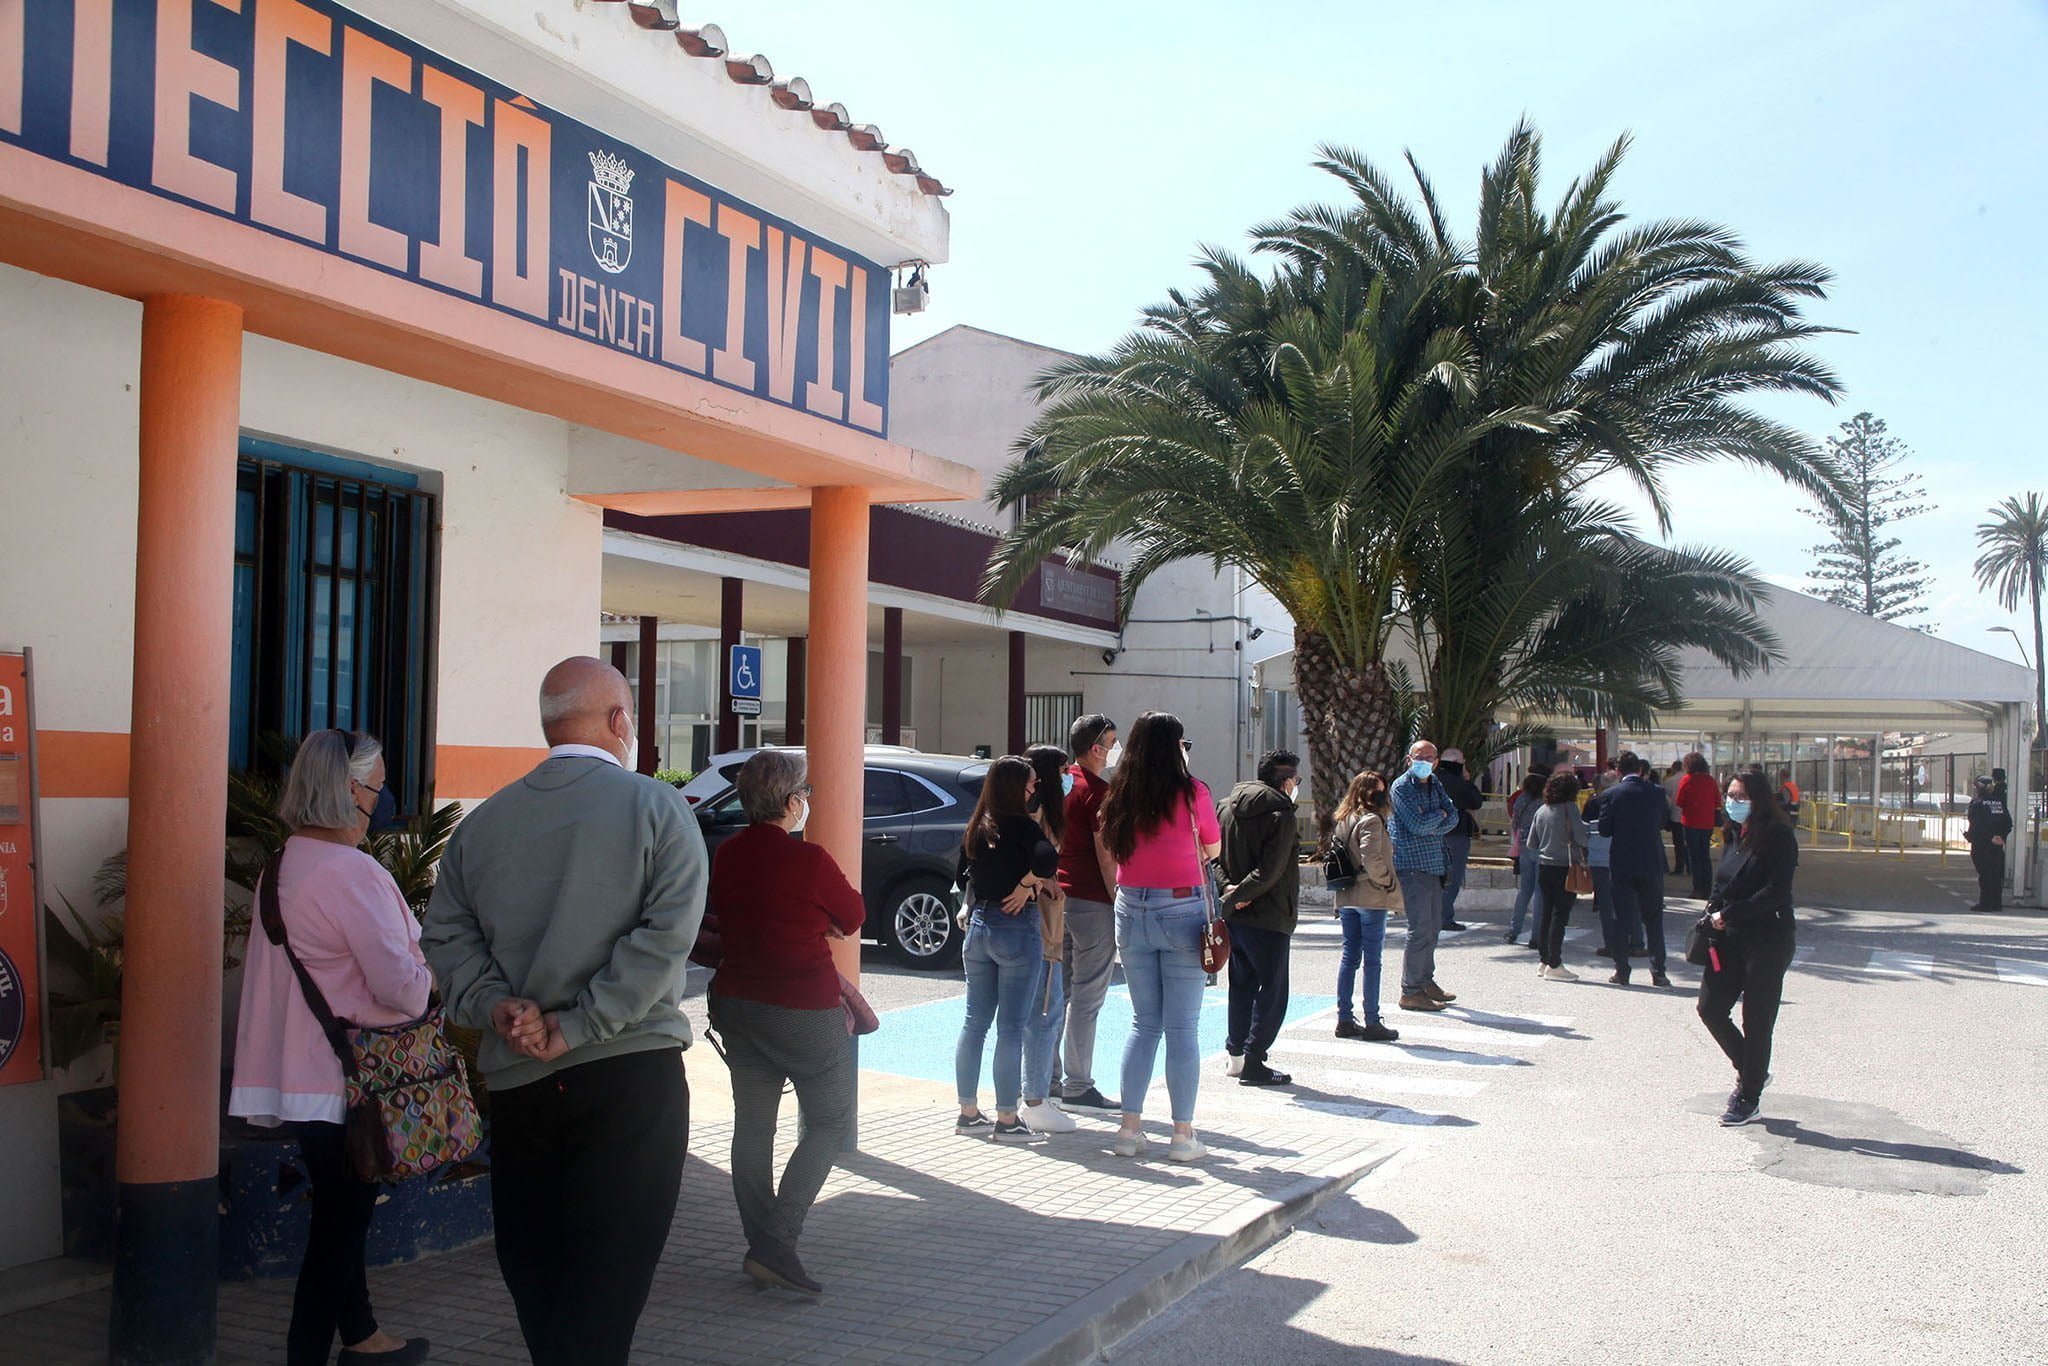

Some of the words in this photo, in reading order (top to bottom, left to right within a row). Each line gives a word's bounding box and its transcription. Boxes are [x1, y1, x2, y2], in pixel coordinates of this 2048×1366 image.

[0, 0, 551, 319] ECCIÓ
[661, 178, 884, 433] CIVIL
[558, 268, 655, 358] DENIA
